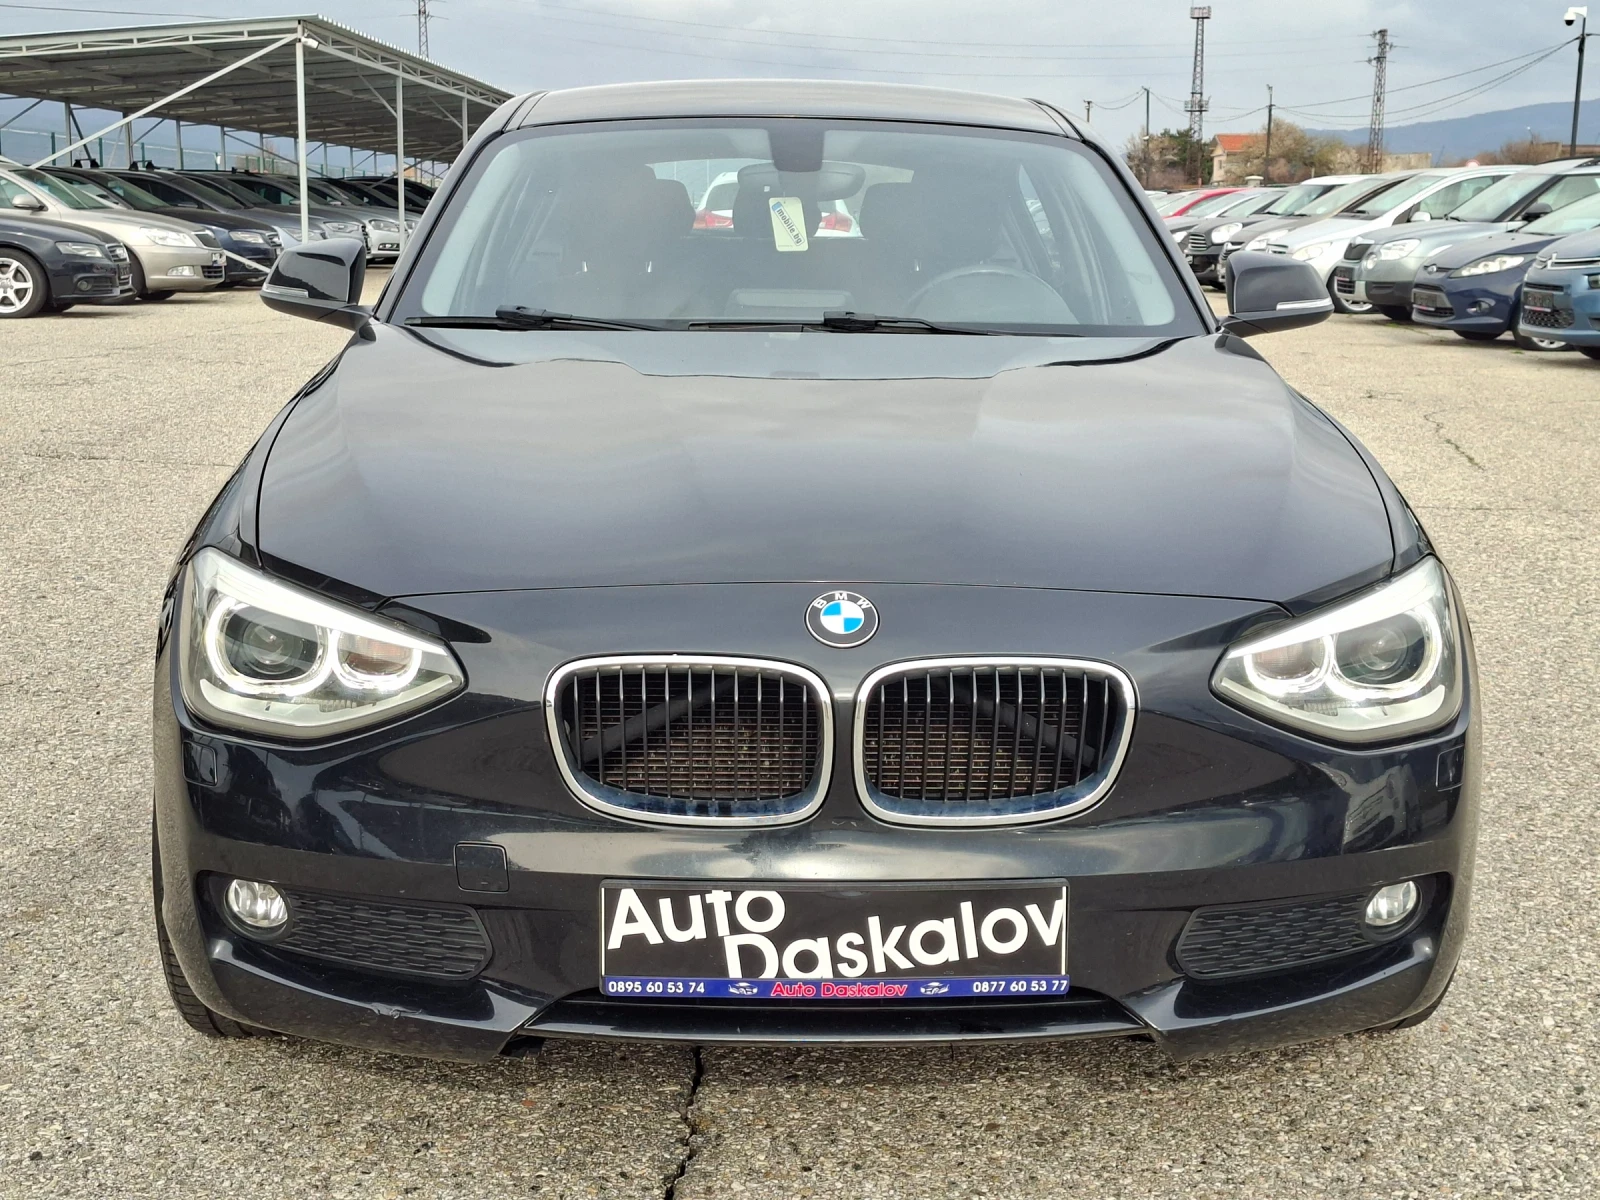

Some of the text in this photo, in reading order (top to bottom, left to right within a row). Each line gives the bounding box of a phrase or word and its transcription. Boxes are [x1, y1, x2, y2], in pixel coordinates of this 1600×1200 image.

[776, 208, 803, 245] mobile.bg
[813, 592, 872, 609] BMW
[607, 888, 786, 950] Auto
[723, 898, 1066, 979] Daskalov
[608, 981, 705, 994] 0895 60 53 74
[770, 981, 909, 998] Auto Daskalov
[972, 979, 1068, 994] 0877 60 53 77
